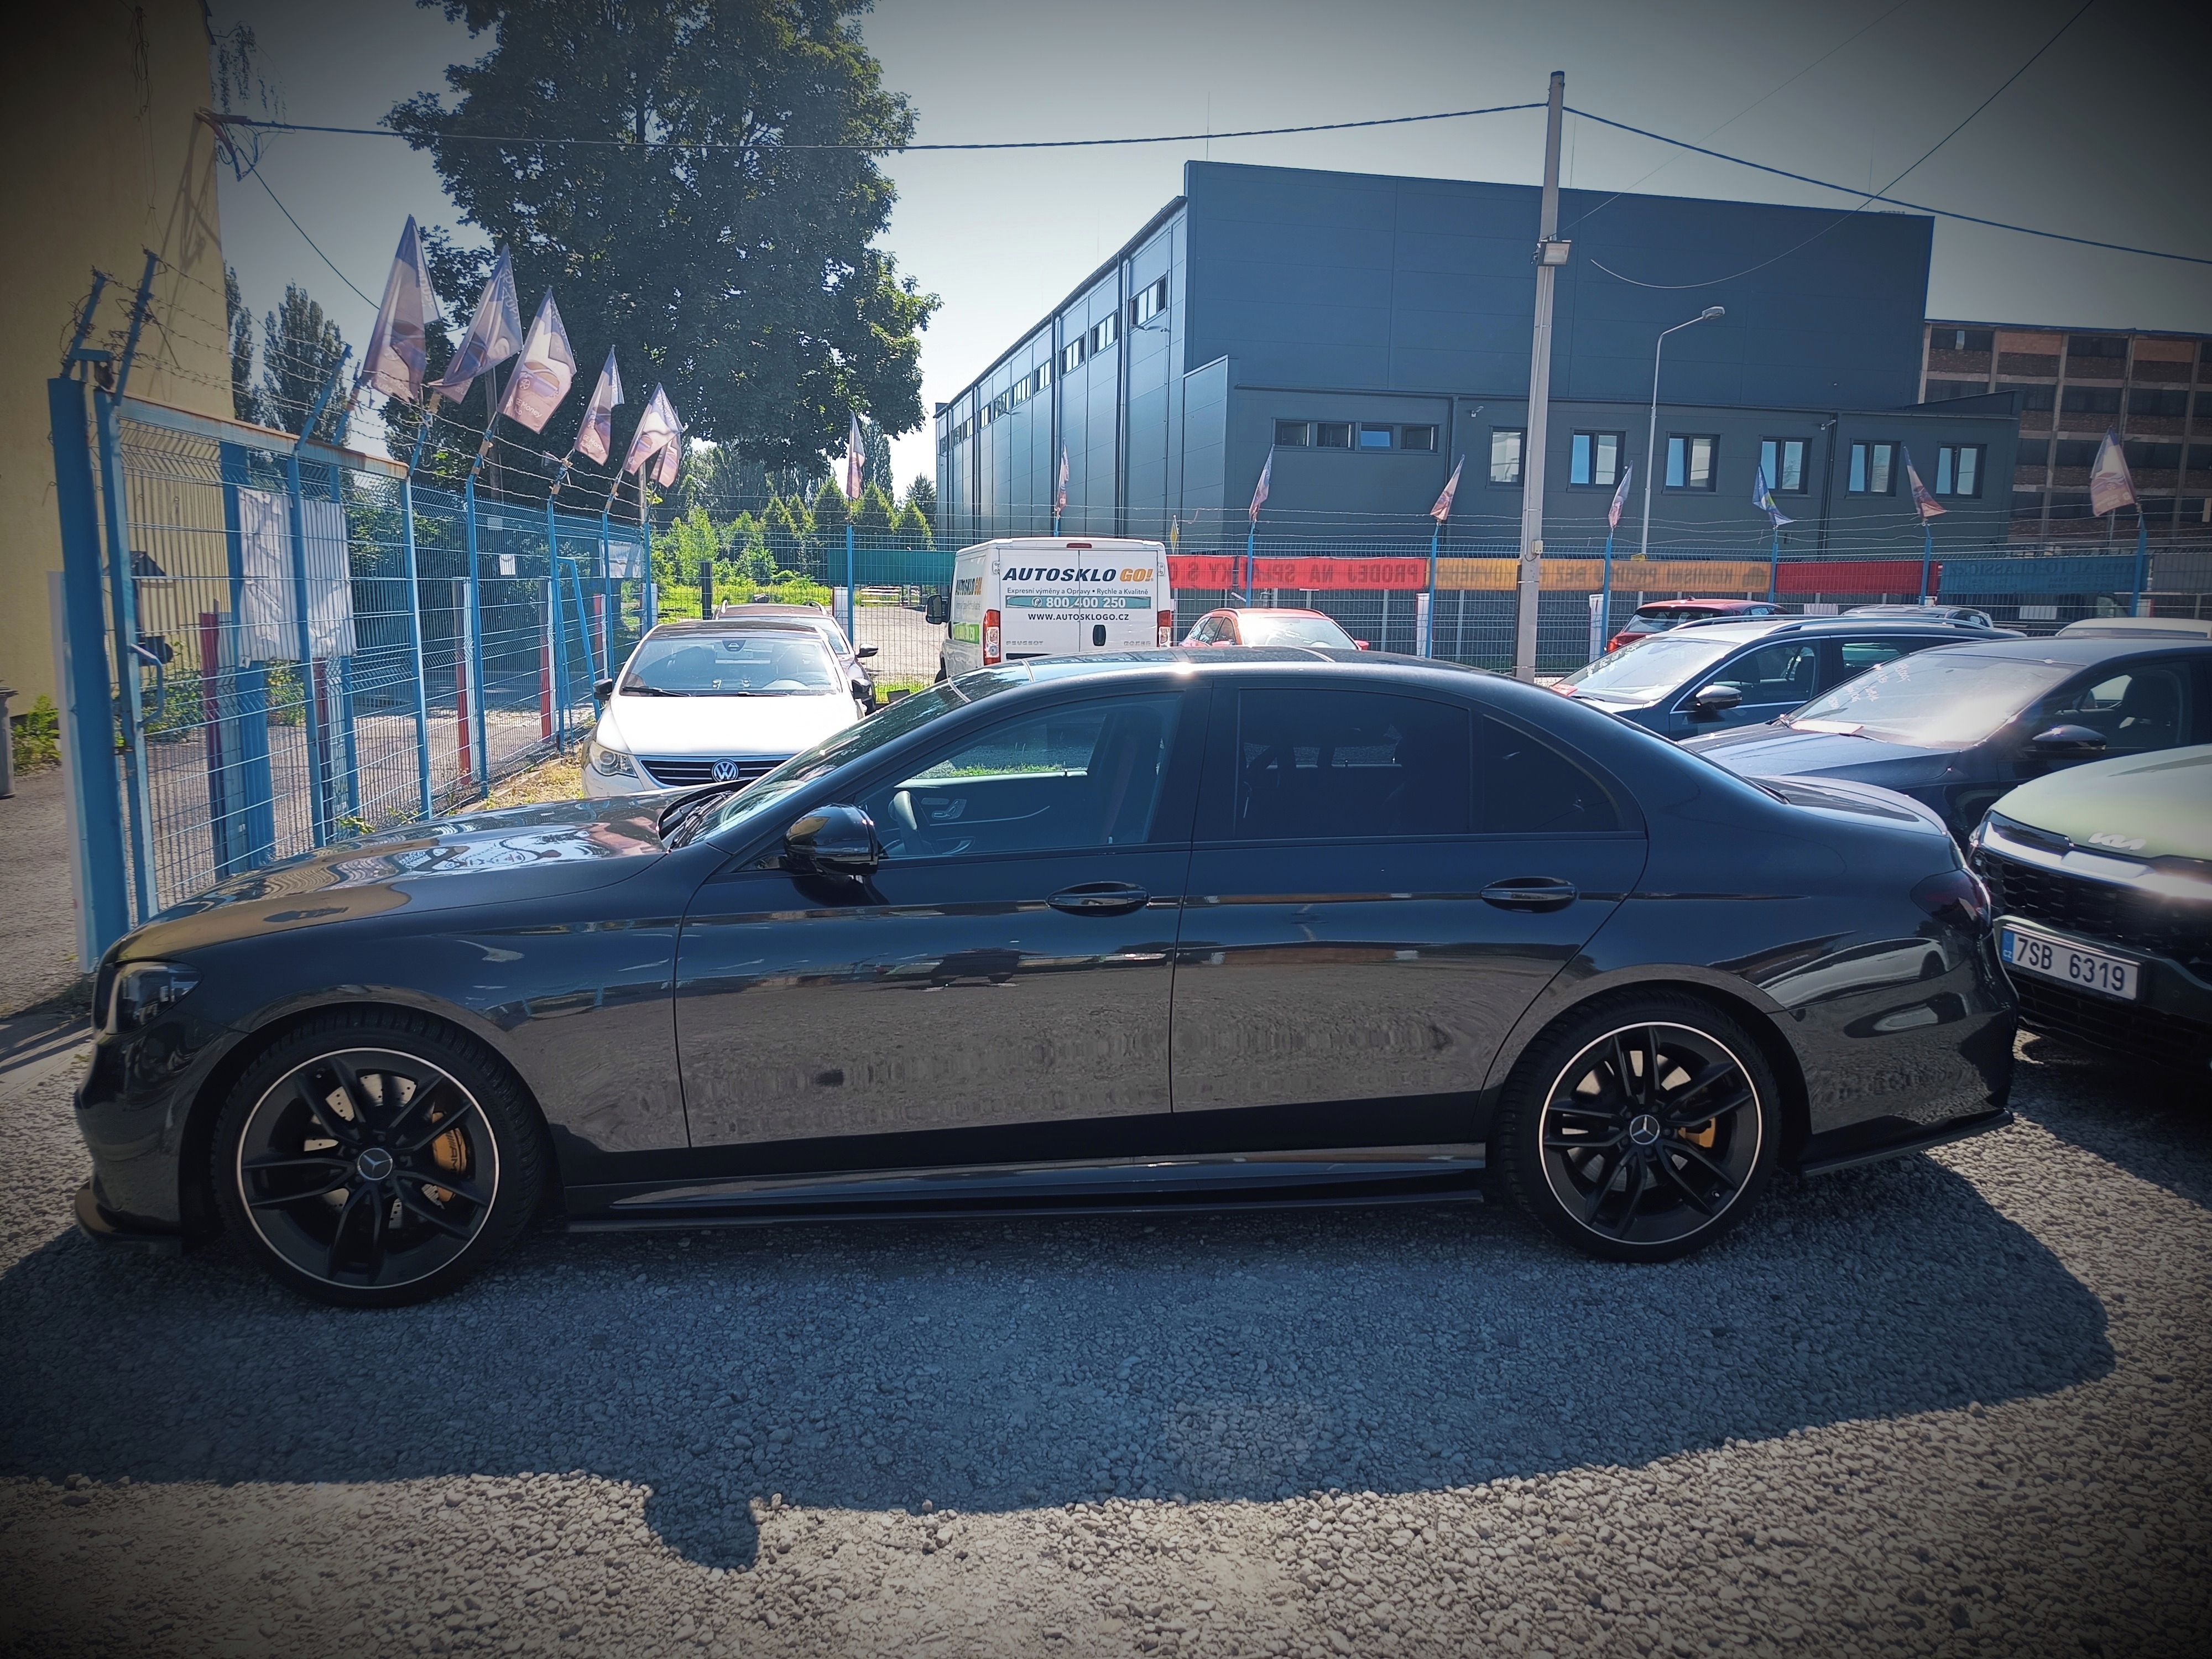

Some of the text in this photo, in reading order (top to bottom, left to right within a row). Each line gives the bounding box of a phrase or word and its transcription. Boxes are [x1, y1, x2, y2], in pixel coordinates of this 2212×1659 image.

[520, 401, 542, 418] Money
[1002, 567, 1153, 582] AUTOSKLO GO!
[955, 578, 975, 596] AUTOSKLO
[1035, 587, 1060, 596] výměny
[1046, 597, 1126, 608] 800 400 250
[2003, 950, 2012, 959] CZ
[2017, 939, 2125, 992] 7SB 6319
